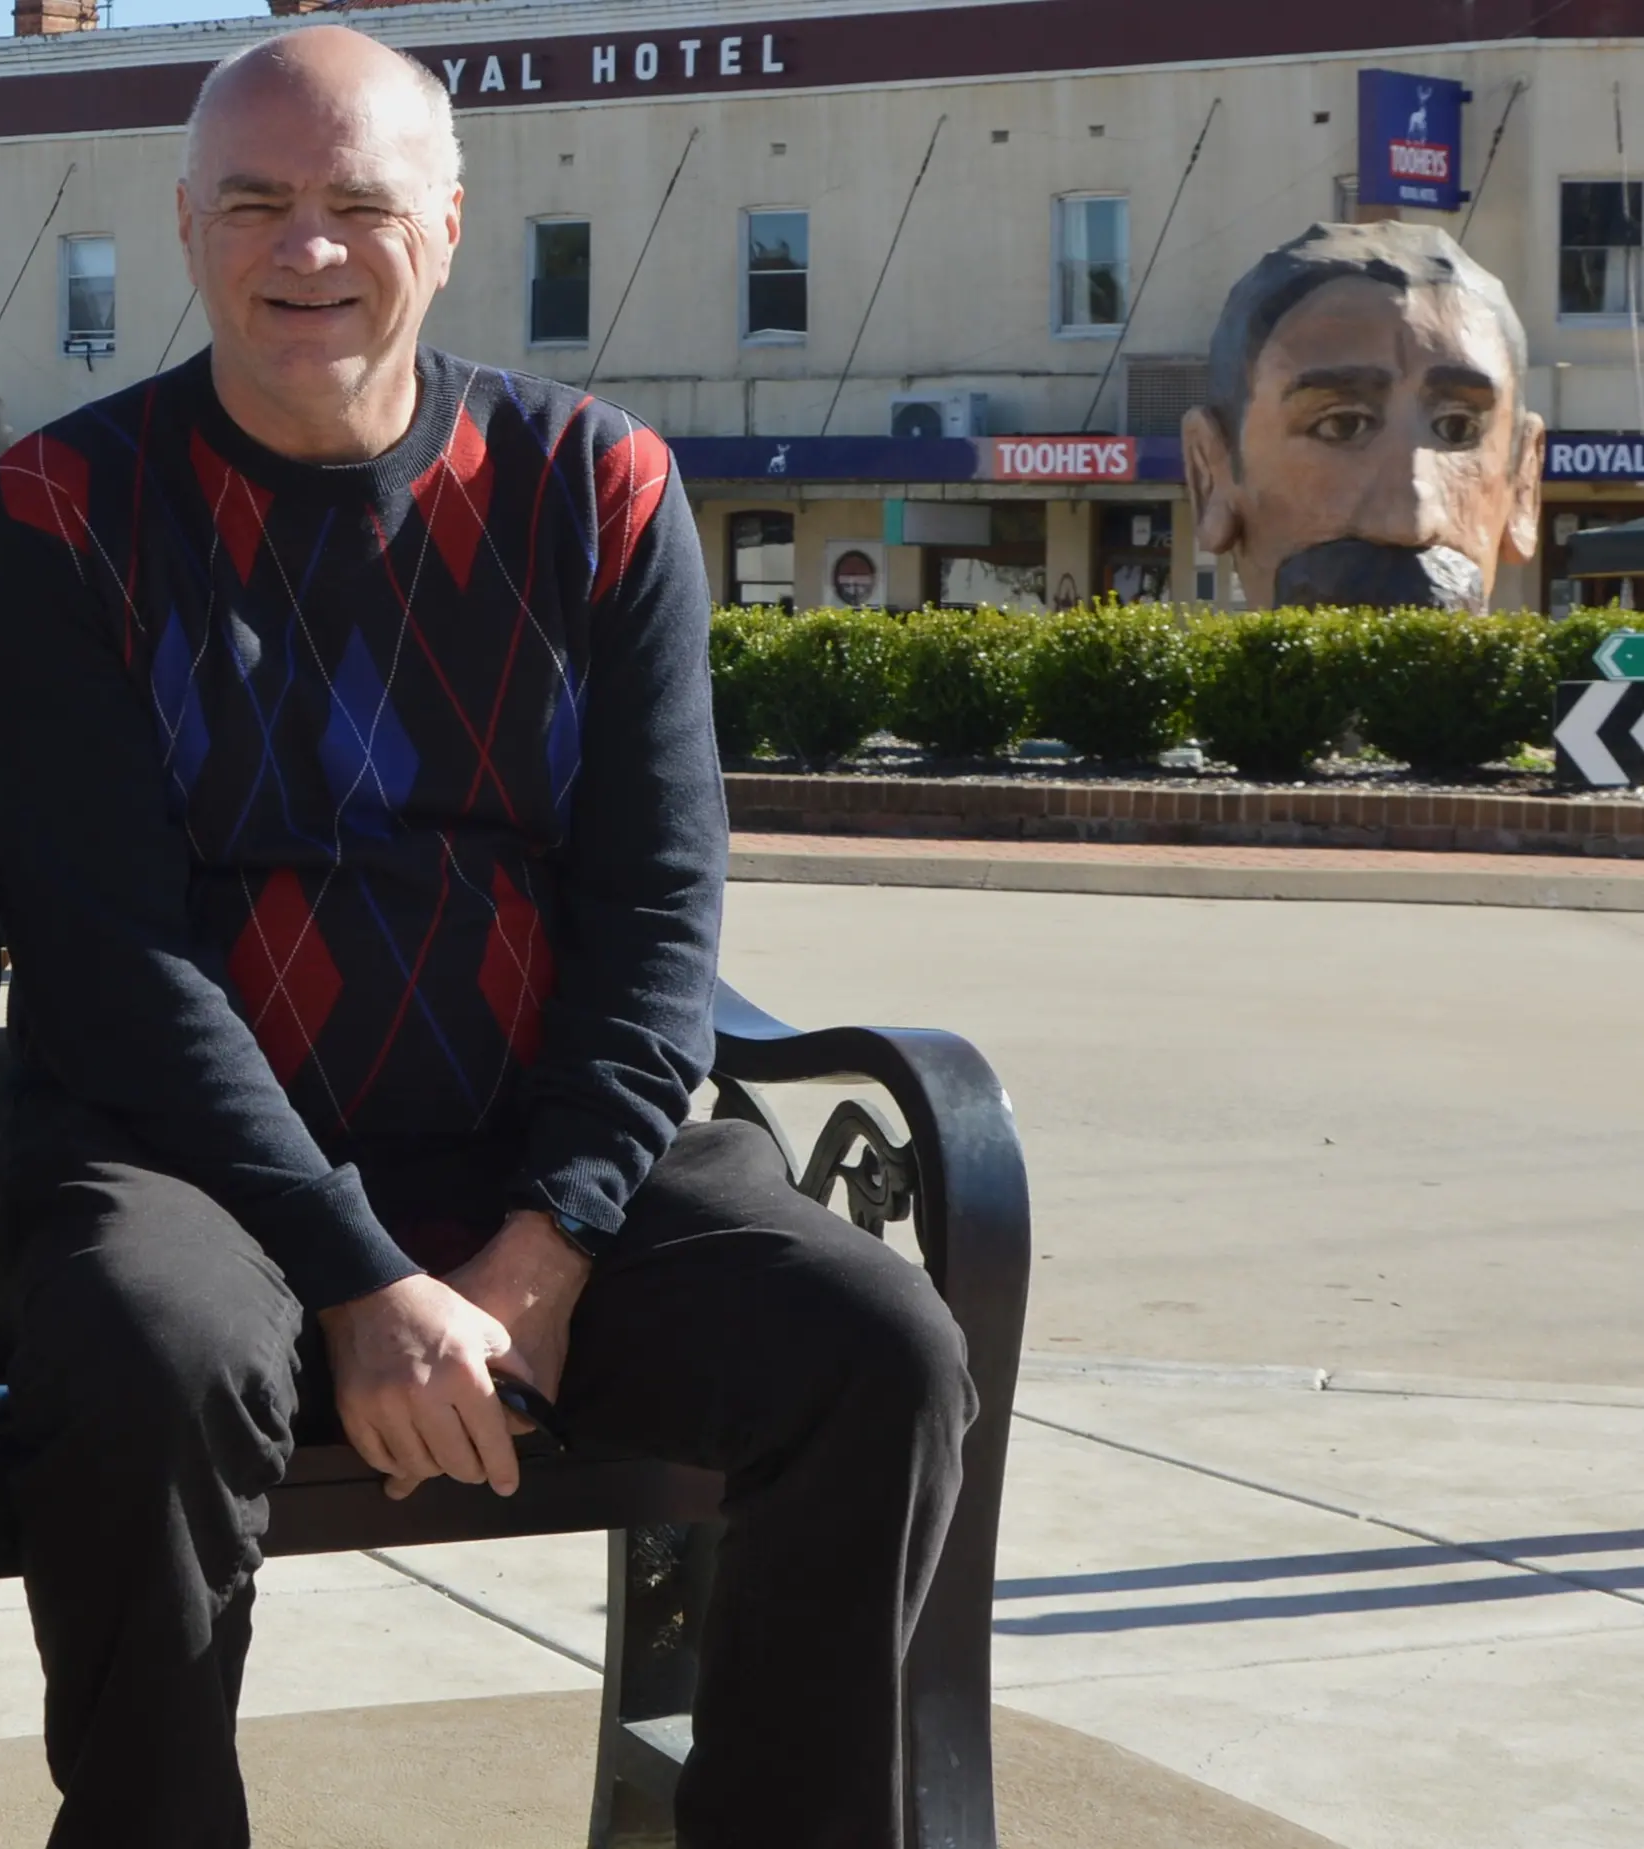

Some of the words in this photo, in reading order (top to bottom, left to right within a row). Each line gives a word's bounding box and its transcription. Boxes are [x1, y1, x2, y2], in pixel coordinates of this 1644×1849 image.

[442, 53, 542, 95] YAL
[592, 34, 784, 83] HOTEL
[997, 442, 1129, 475] TOOHEYS
[1551, 443, 1644, 473] ROYAL
